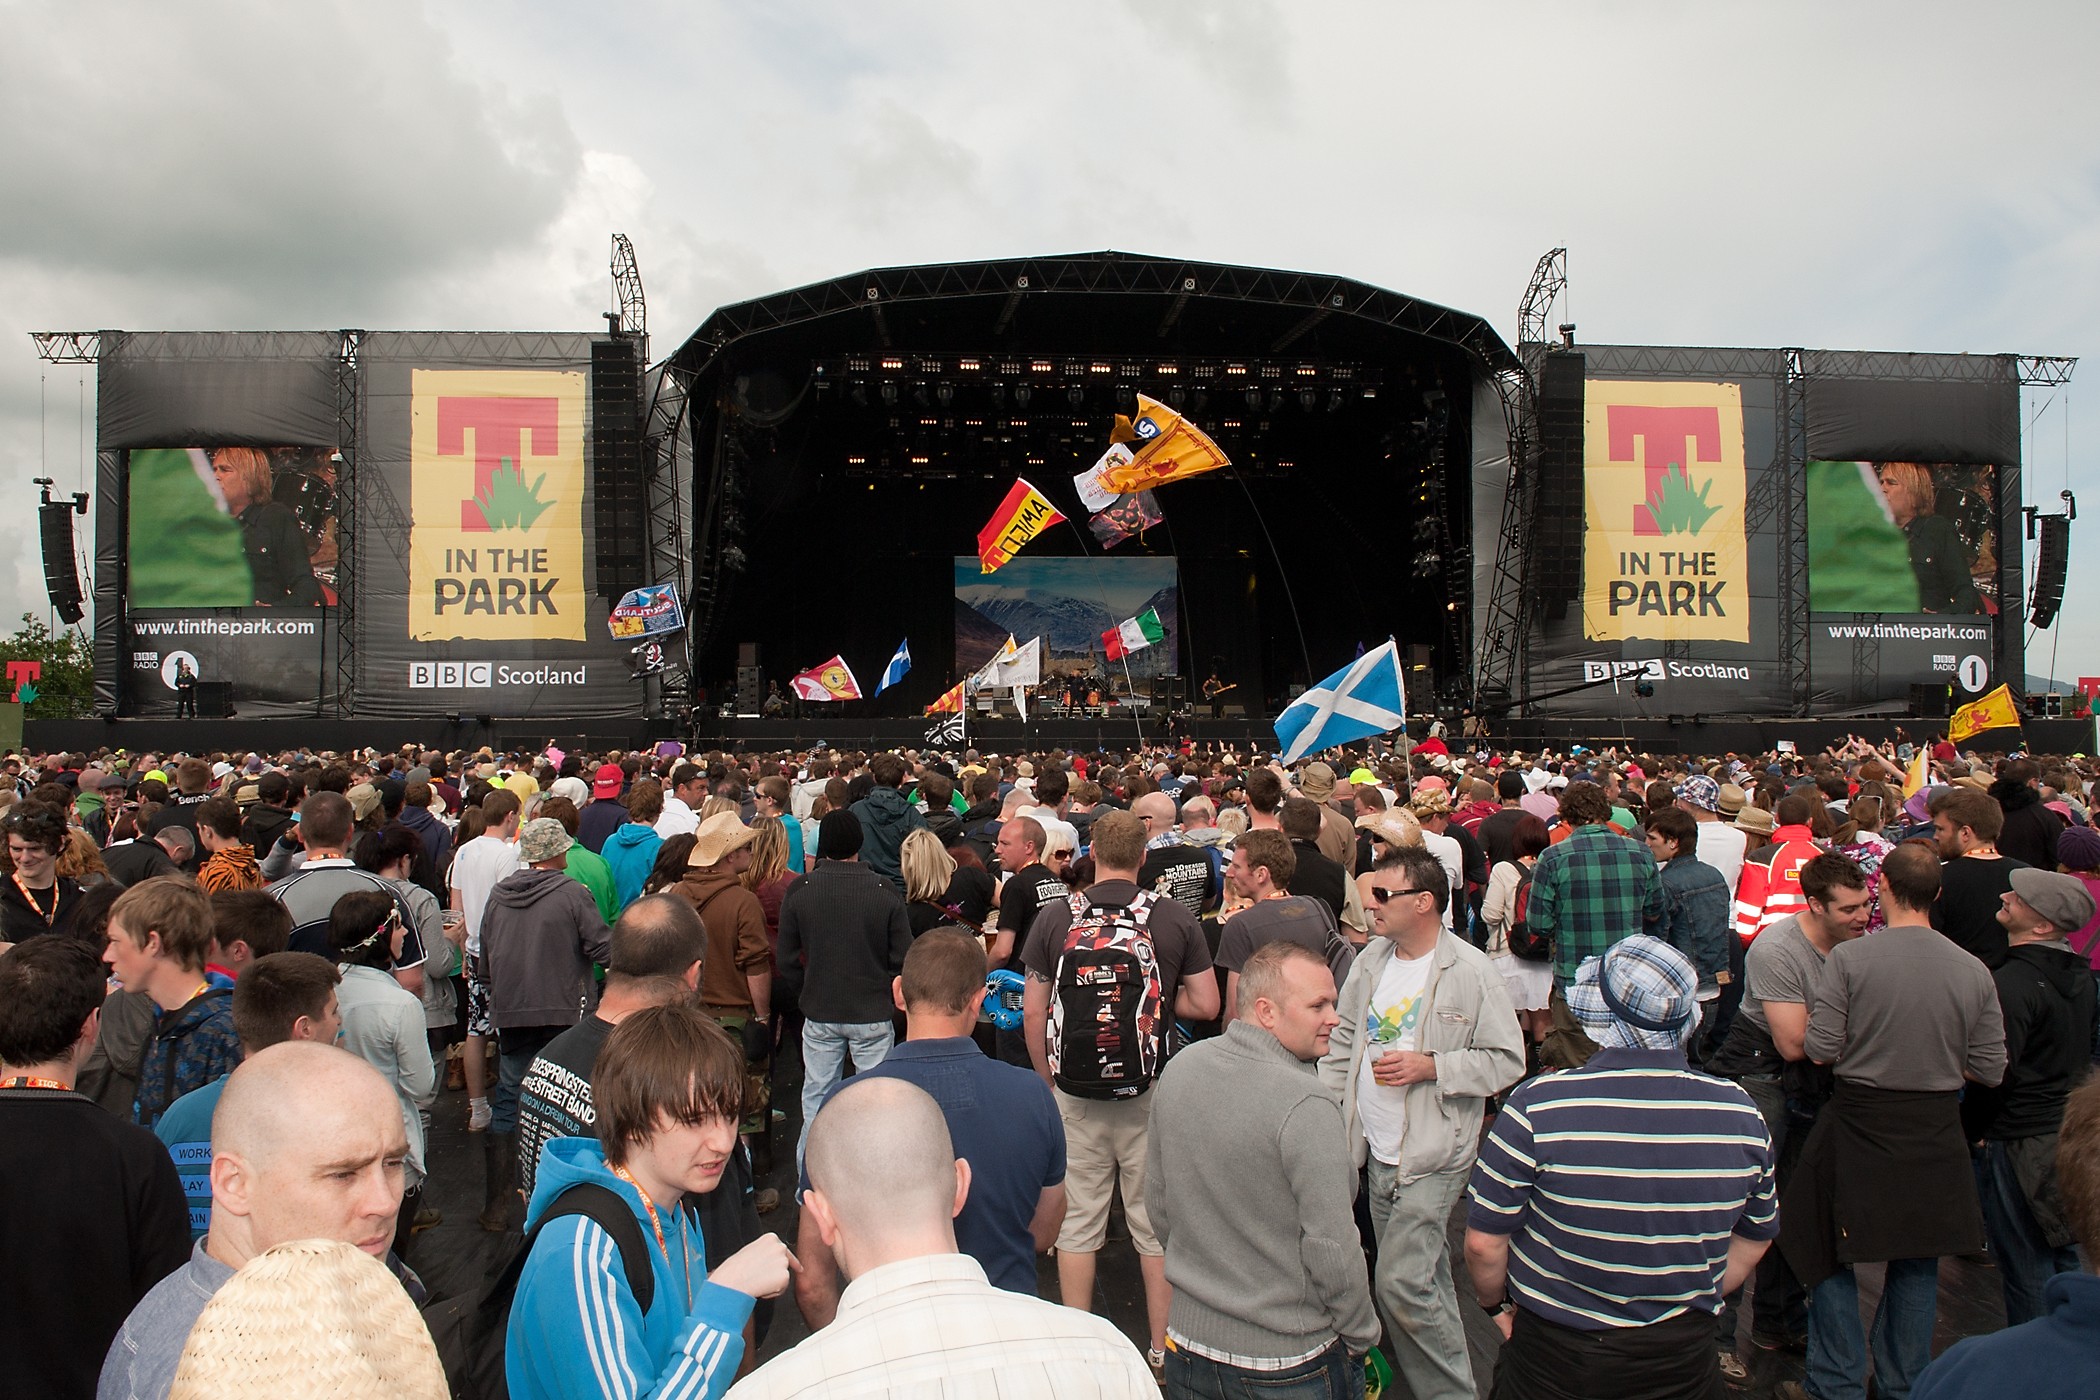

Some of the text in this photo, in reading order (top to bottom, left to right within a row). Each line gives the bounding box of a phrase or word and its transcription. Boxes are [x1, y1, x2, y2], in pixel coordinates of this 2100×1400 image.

[445, 549, 548, 573] IN THE
[1620, 552, 1716, 576] IN THE
[434, 578, 560, 615] PARK
[1608, 580, 1727, 617] PARK
[134, 618, 315, 636] www.tinthepark.com
[1828, 623, 1987, 640] www.tinthepark.com
[133, 652, 158, 661] BBC
[133, 661, 159, 669] RADIO
[1933, 655, 1956, 663] BBC
[411, 664, 586, 687] BBC Scotland
[1668, 660, 1750, 680] Scotland
[1933, 663, 1956, 672] RADIO
[1968, 660, 1978, 687] 1
[178, 794, 210, 805] Bench
[1166, 867, 1208, 881] MOUNTAINS
[1175, 864, 1185, 872] 10
[566, 1094, 597, 1125] BAND
[564, 1116, 580, 1134] TOUR
[179, 1148, 212, 1159] WORK
[183, 1181, 203, 1191] LAY
[190, 1213, 206, 1223] AIN
